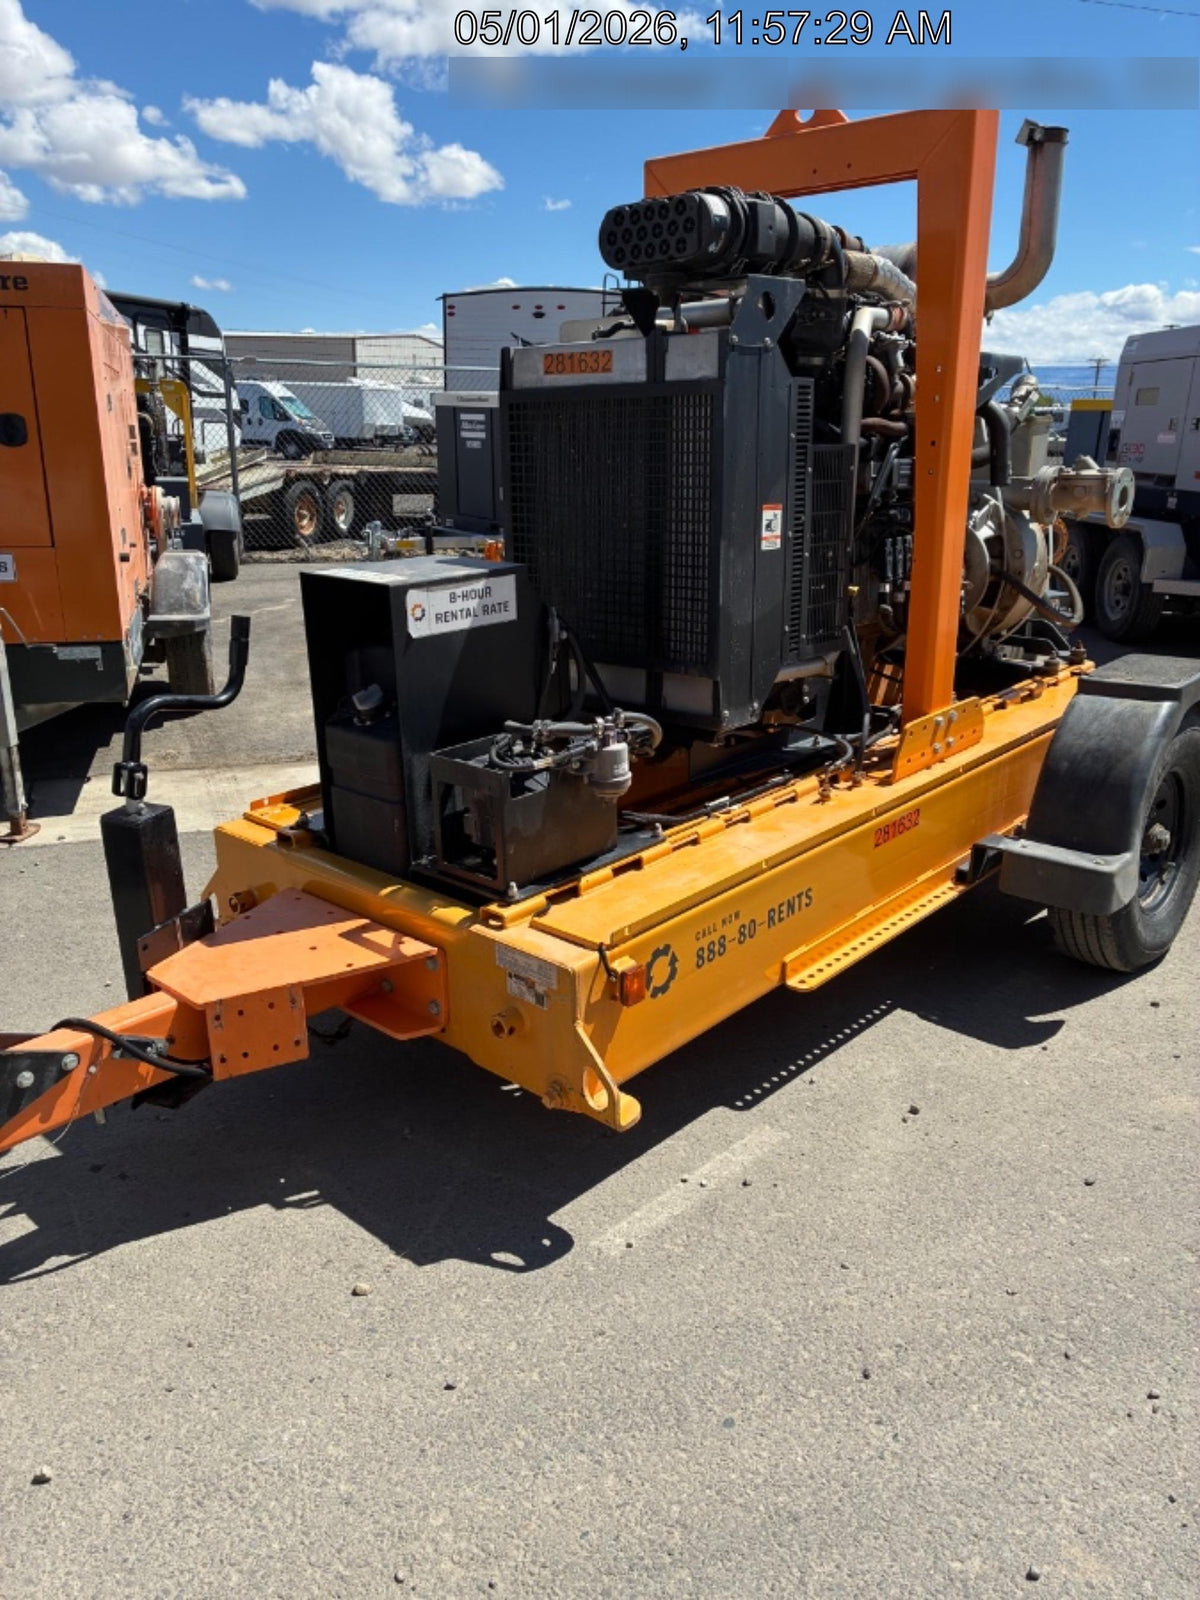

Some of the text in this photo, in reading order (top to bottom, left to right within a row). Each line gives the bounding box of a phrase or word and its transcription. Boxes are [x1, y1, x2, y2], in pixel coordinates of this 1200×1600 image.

[543, 350, 613, 375] 281632
[435, 600, 510, 625] RENTAL RATE
[873, 808, 920, 849] 281632
[695, 910, 741, 942] CALL NOW
[696, 887, 813, 970] 888-80-RENTS
